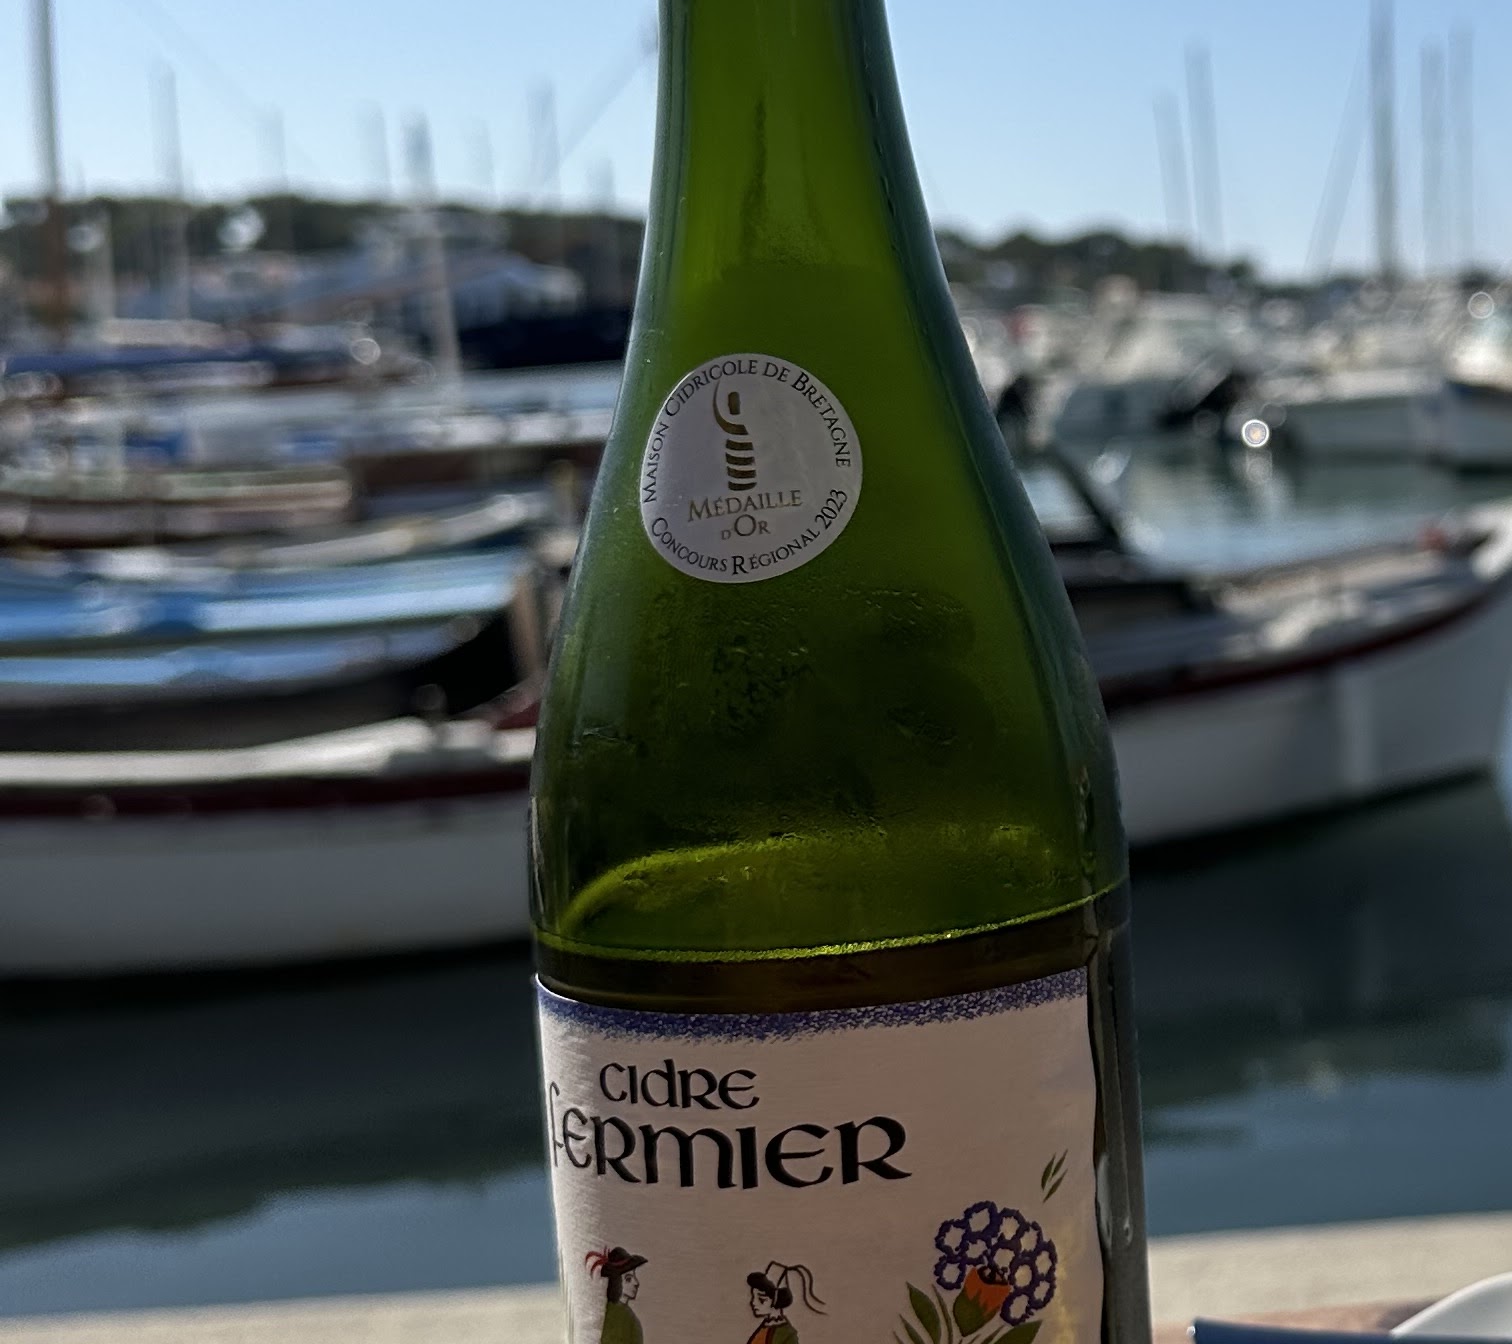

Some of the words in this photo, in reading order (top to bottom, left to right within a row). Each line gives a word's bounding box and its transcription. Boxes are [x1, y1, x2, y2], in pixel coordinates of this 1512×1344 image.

[642, 422, 670, 504] MAISON
[664, 359, 759, 418] CIDRICOLE
[762, 362, 790, 383] DE
[791, 370, 851, 469] BRETAGNE
[650, 516, 728, 573] CONCOURS
[731, 527, 821, 576] RÉGIONAL
[814, 488, 849, 531] 2023
[687, 489, 804, 523] MÉDAILLE
